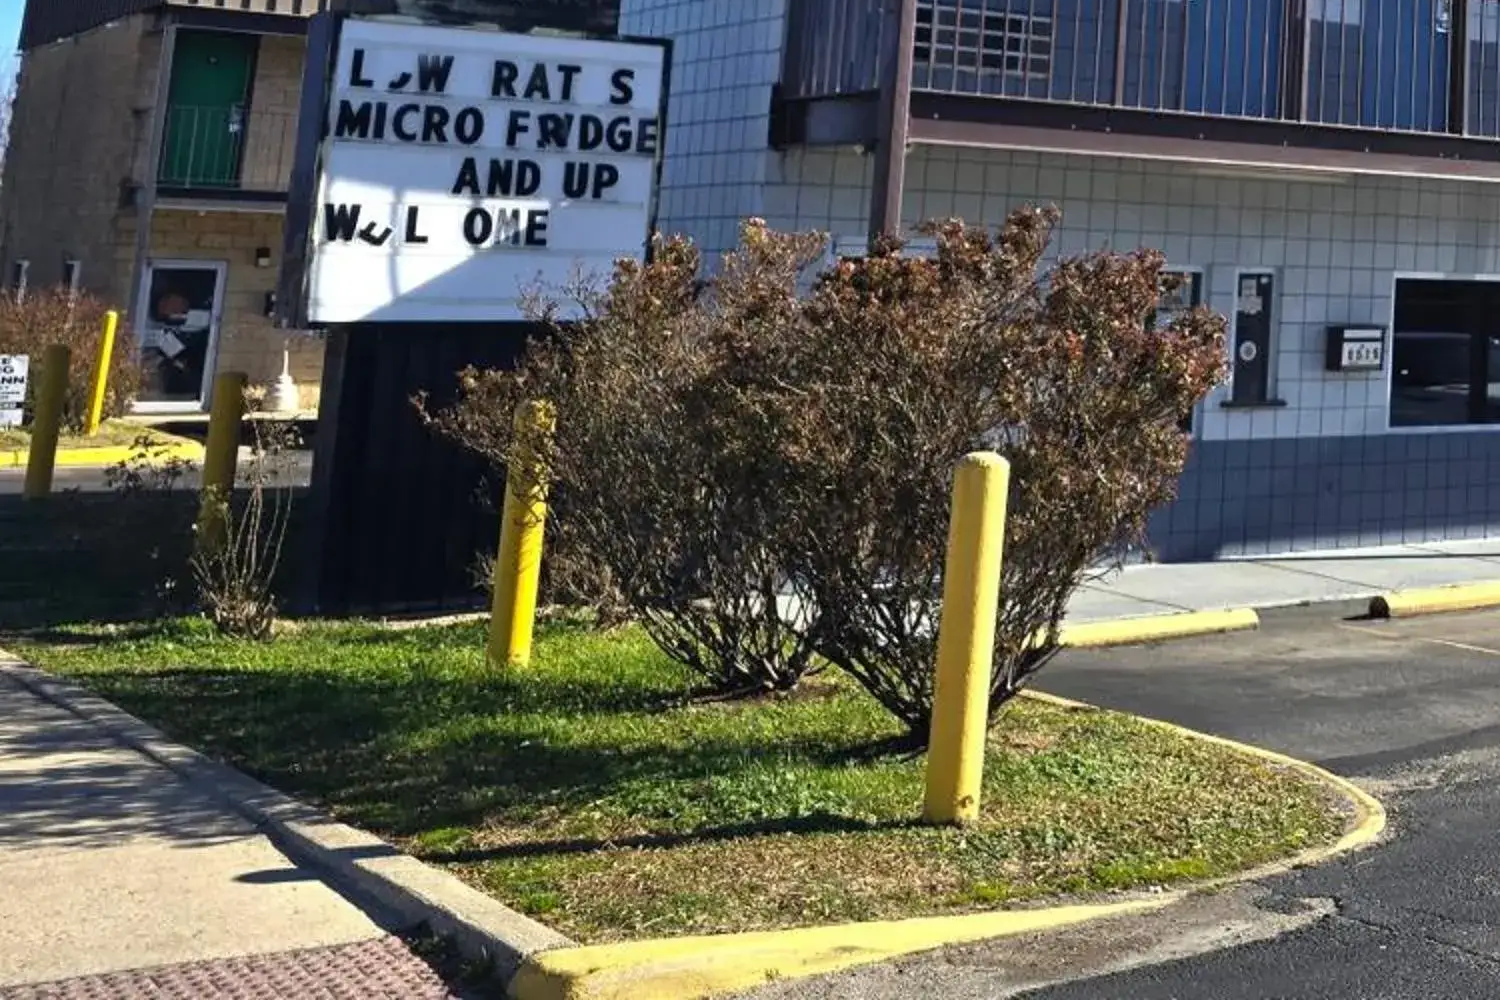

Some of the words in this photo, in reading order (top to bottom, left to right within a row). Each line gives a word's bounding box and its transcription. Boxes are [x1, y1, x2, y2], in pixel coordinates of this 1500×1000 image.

[350, 48, 455, 93] LW
[335, 99, 485, 146] MICRO
[452, 157, 542, 197] AND
[562, 161, 619, 199] UP
